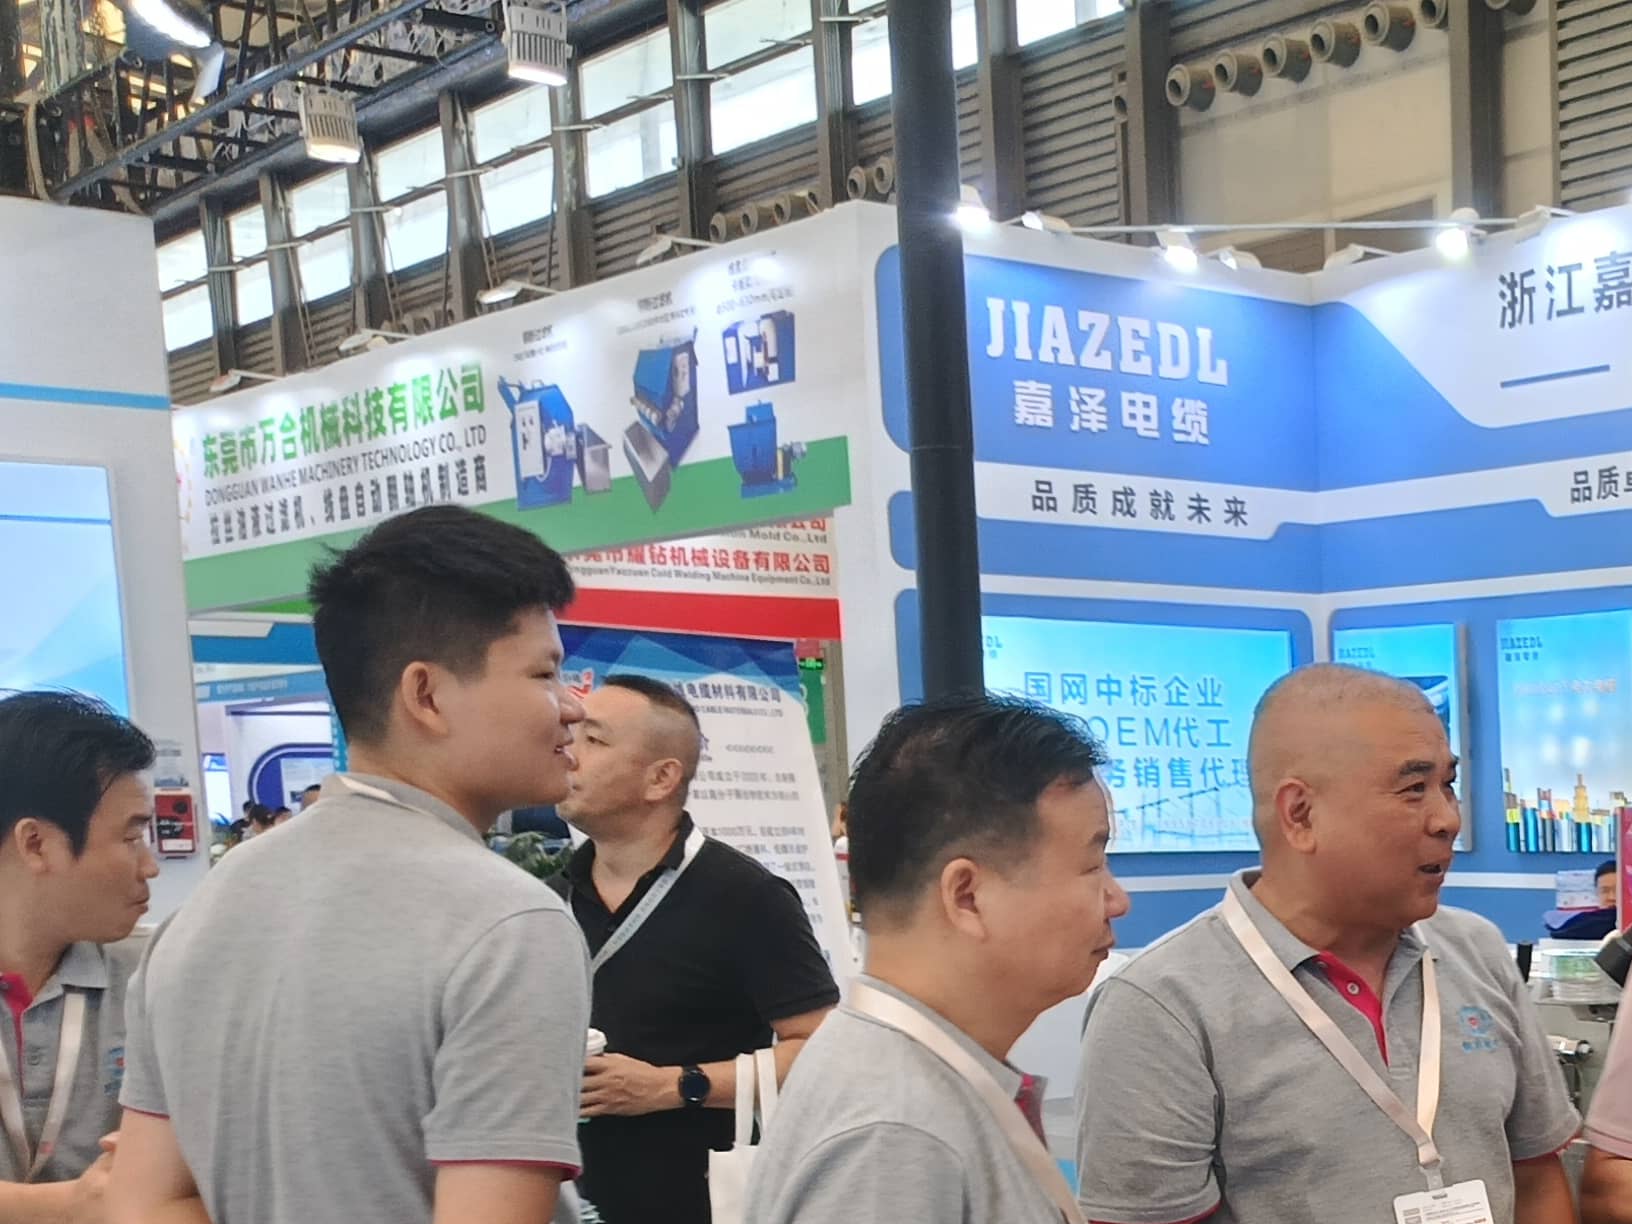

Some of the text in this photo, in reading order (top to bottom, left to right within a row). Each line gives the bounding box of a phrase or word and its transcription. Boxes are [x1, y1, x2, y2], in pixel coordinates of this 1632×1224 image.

[986, 296, 1228, 387] JIAZEDL
[202, 363, 487, 479] 东莞市万合机械科技有限公司
[1013, 380, 1210, 446] 嘉泽电缆
[204, 480, 261, 507] DONGGUAN
[299, 455, 359, 487] MACHINERY
[361, 436, 437, 471] TECHNOLOGY
[465, 424, 487, 448] LTD
[1031, 479, 1249, 528] 品质成就未来
[1023, 671, 1224, 708] 国网中标企业
